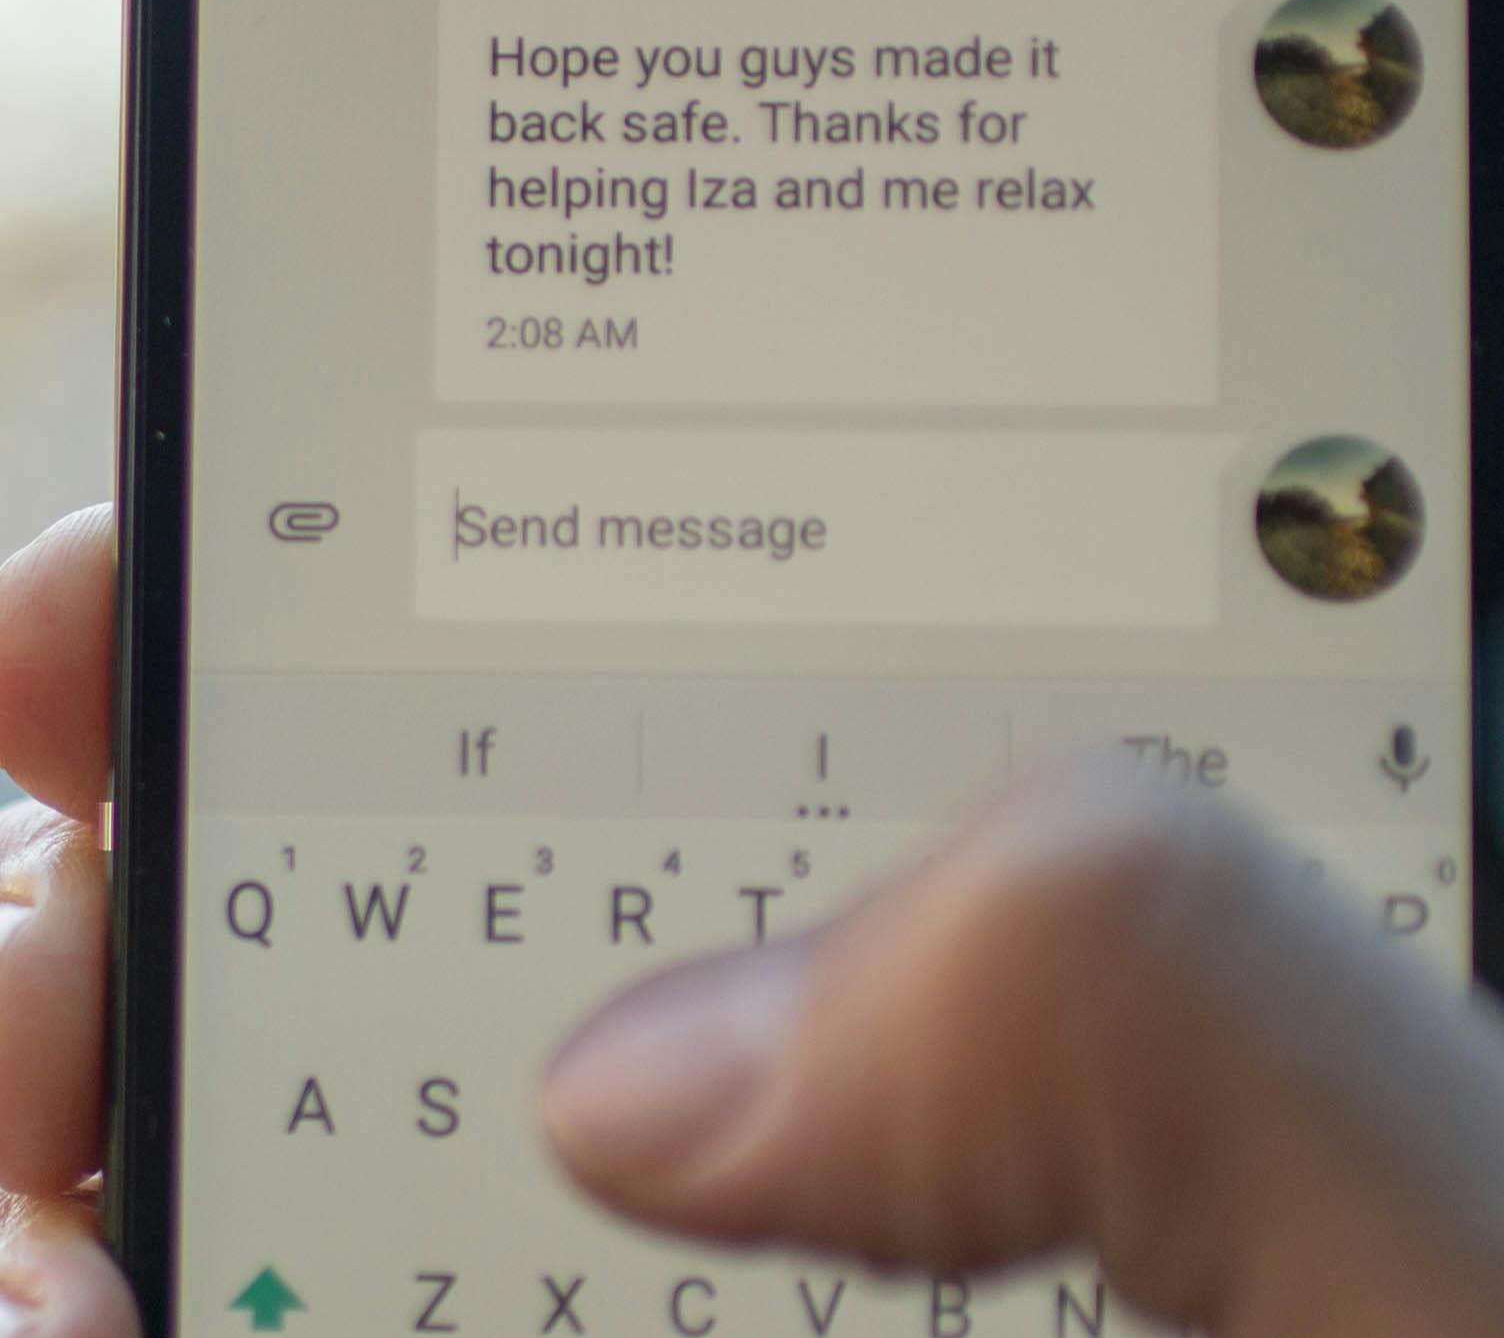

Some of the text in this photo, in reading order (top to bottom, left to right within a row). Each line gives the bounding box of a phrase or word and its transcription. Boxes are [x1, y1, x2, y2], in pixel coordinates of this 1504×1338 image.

[490, 37, 1058, 88] Hope you guys made it
[490, 102, 1027, 144] back safe. Thanks for
[489, 167, 668, 219] helping
[776, 169, 863, 210] and
[883, 177, 958, 210] me
[976, 169, 1095, 210] relax
[486, 235, 674, 285] tonight!
[486, 318, 638, 349] 2:08 AM
[458, 505, 826, 560] Send message
[460, 729, 496, 775] If
[1121, 735, 1227, 787] The
[283, 847, 295, 870] 1
[408, 848, 426, 872] 2
[536, 850, 553, 875] 3
[663, 851, 681, 875] 4
[227, 881, 273, 947] Q
[345, 883, 409, 940] W
[486, 886, 523, 942] E
[613, 887, 653, 943] R
[738, 887, 783, 945] T
[287, 1077, 459, 1137] A S
[415, 1274, 457, 1332] Z
[542, 1276, 584, 1334] X
[671, 1278, 715, 1337] C
[799, 1280, 844, 1338] V
